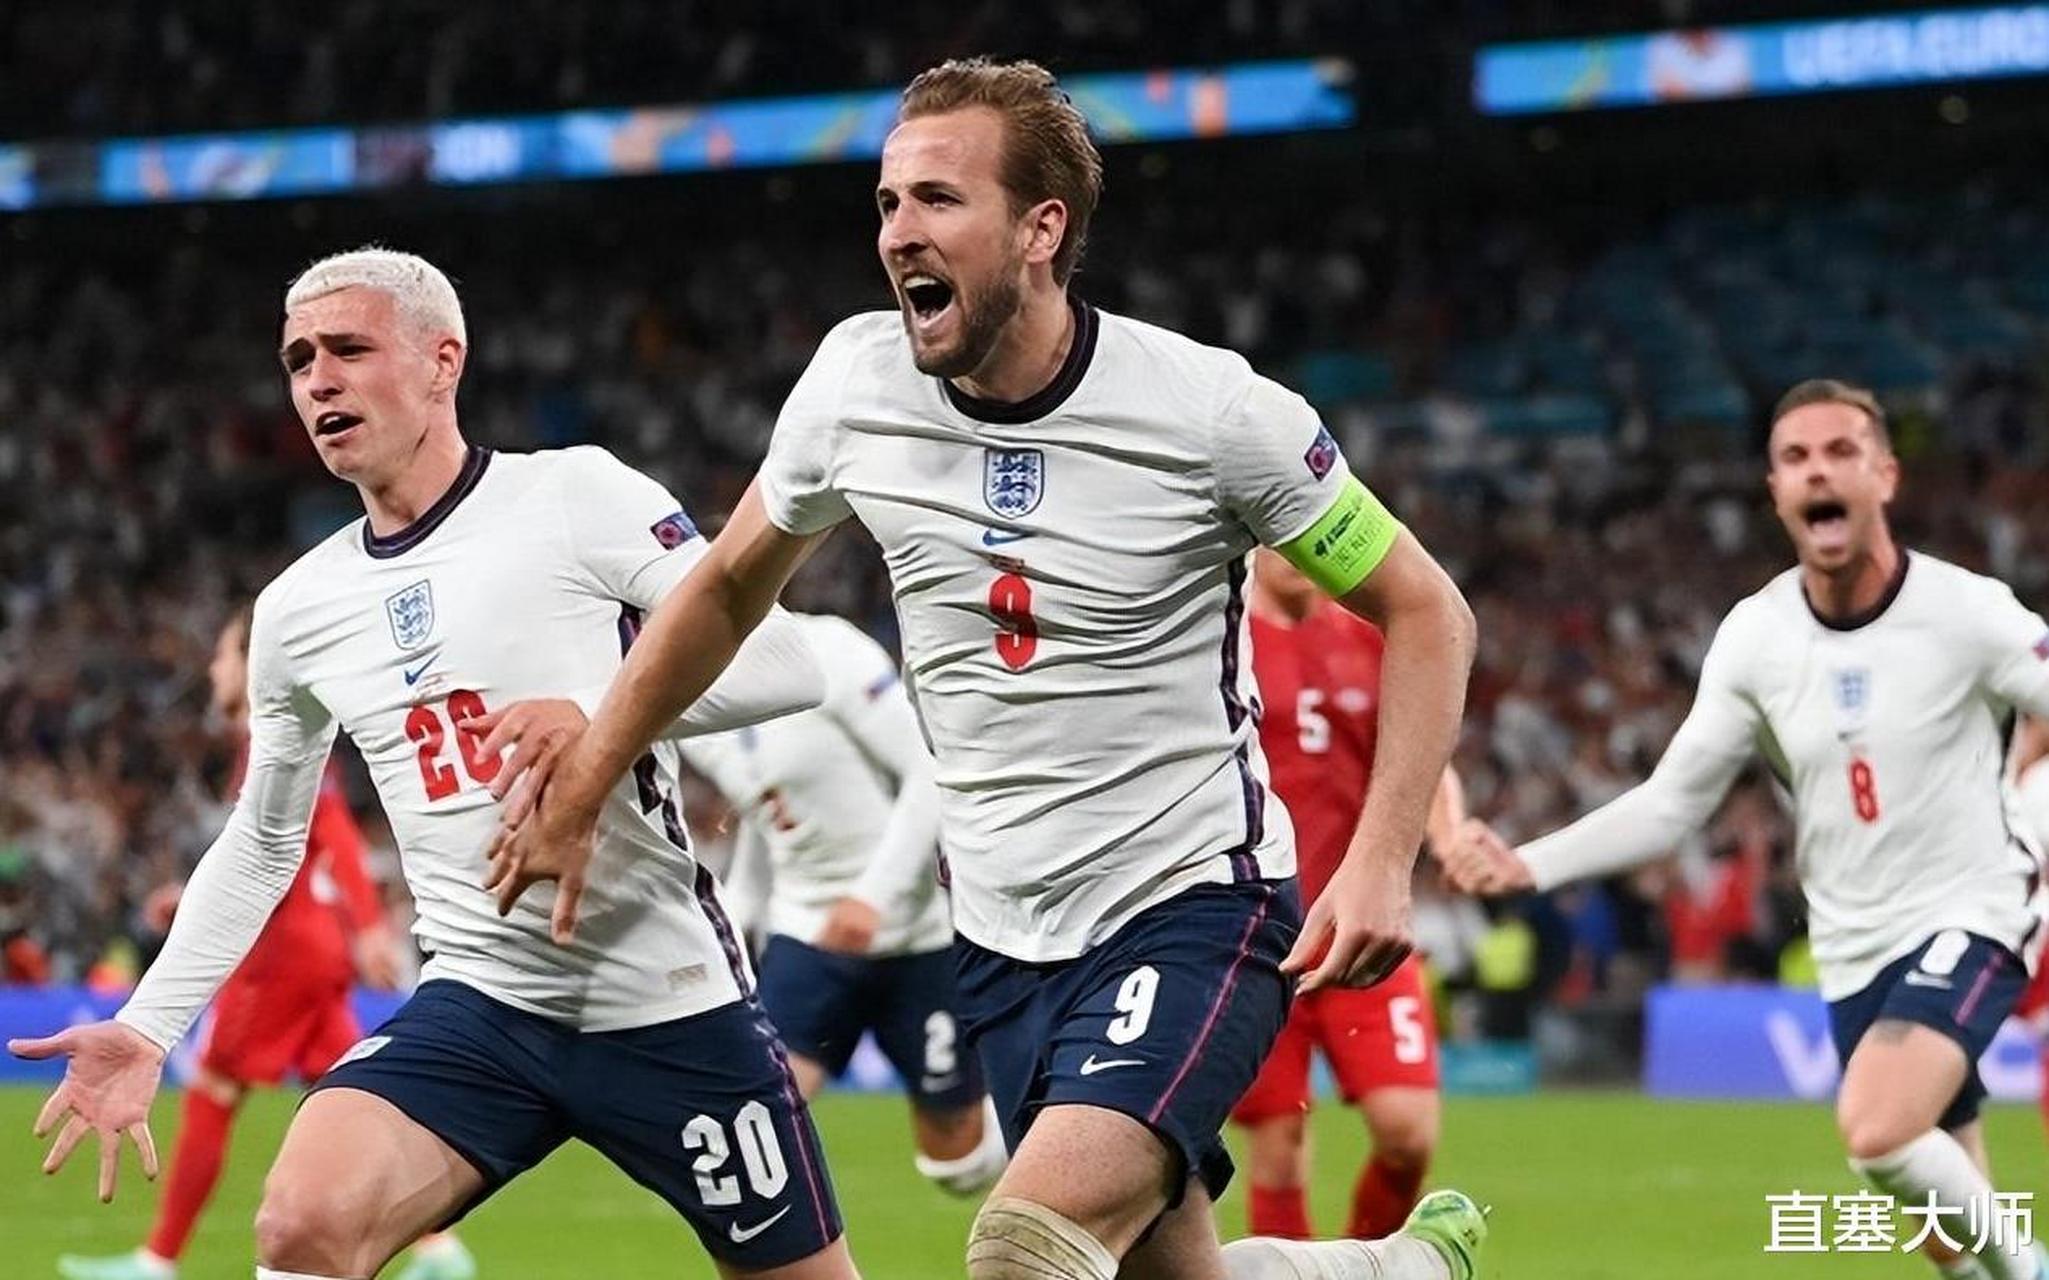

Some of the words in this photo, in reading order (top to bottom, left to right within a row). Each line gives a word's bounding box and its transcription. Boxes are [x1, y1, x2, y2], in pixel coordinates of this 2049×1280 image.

[988, 573, 1037, 671] 9
[1296, 688, 1331, 754] 5
[1849, 759, 1879, 824] 8
[1105, 965, 1161, 1046] 9
[1388, 996, 1427, 1064] 5
[924, 1009, 957, 1074] 2
[681, 1099, 789, 1207] 20
